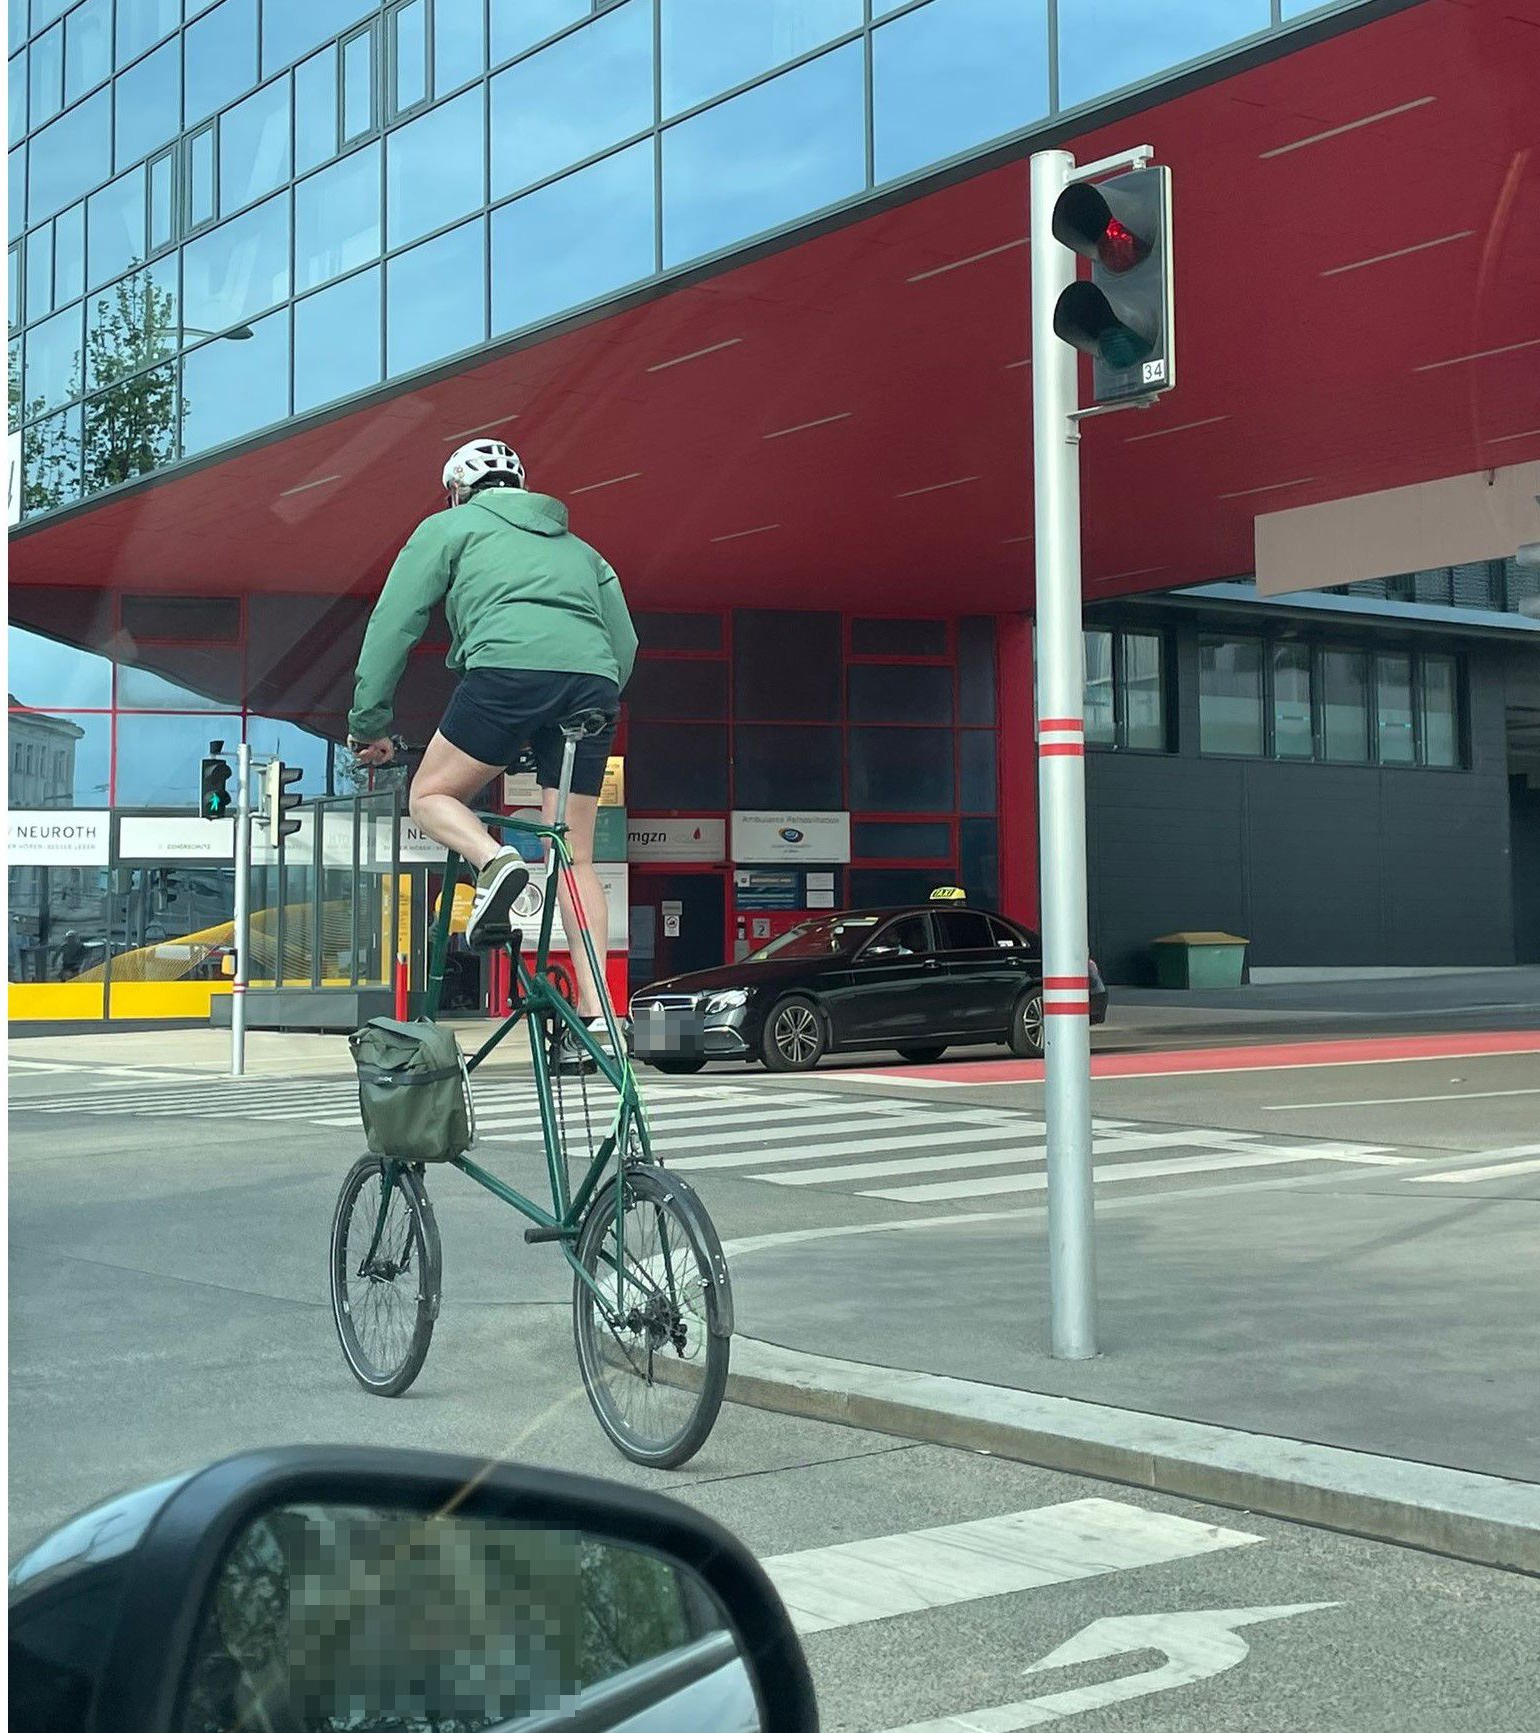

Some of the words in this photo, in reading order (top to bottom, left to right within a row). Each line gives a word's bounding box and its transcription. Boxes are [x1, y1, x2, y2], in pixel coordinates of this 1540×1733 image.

[1144, 362, 1162, 380] 34
[17, 826, 97, 839] NEUROTH
[627, 831, 667, 846] mgzn
